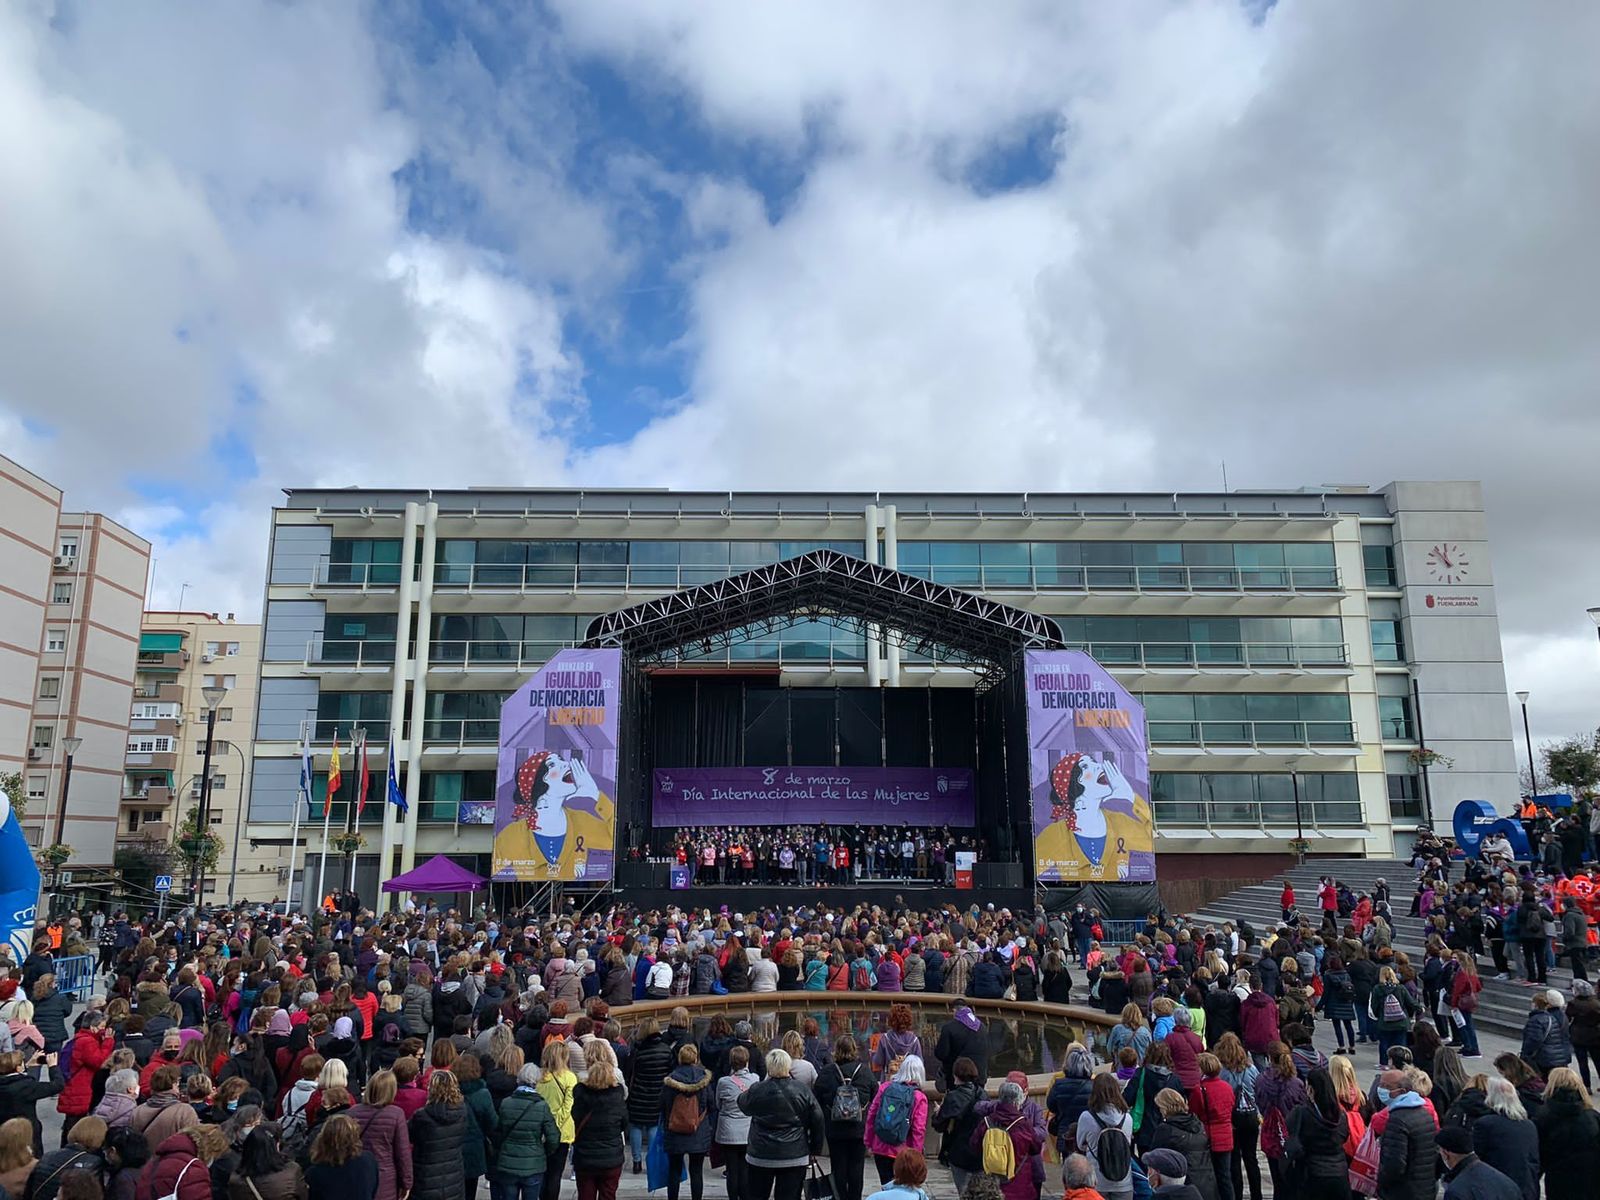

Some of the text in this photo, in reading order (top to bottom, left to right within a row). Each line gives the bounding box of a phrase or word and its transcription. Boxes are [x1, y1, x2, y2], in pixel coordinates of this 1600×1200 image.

[545, 671, 602, 689] IGUALDAD
[1034, 673, 1091, 691] IGUALDAD
[529, 689, 605, 707] DEMOCRACIA
[1041, 692, 1117, 709] DEMOCRACIA
[762, 768, 851, 785] 8 de marzo
[682, 785, 930, 806] Día Internacional de las Mujeres
[1046, 858, 1055, 866] de
